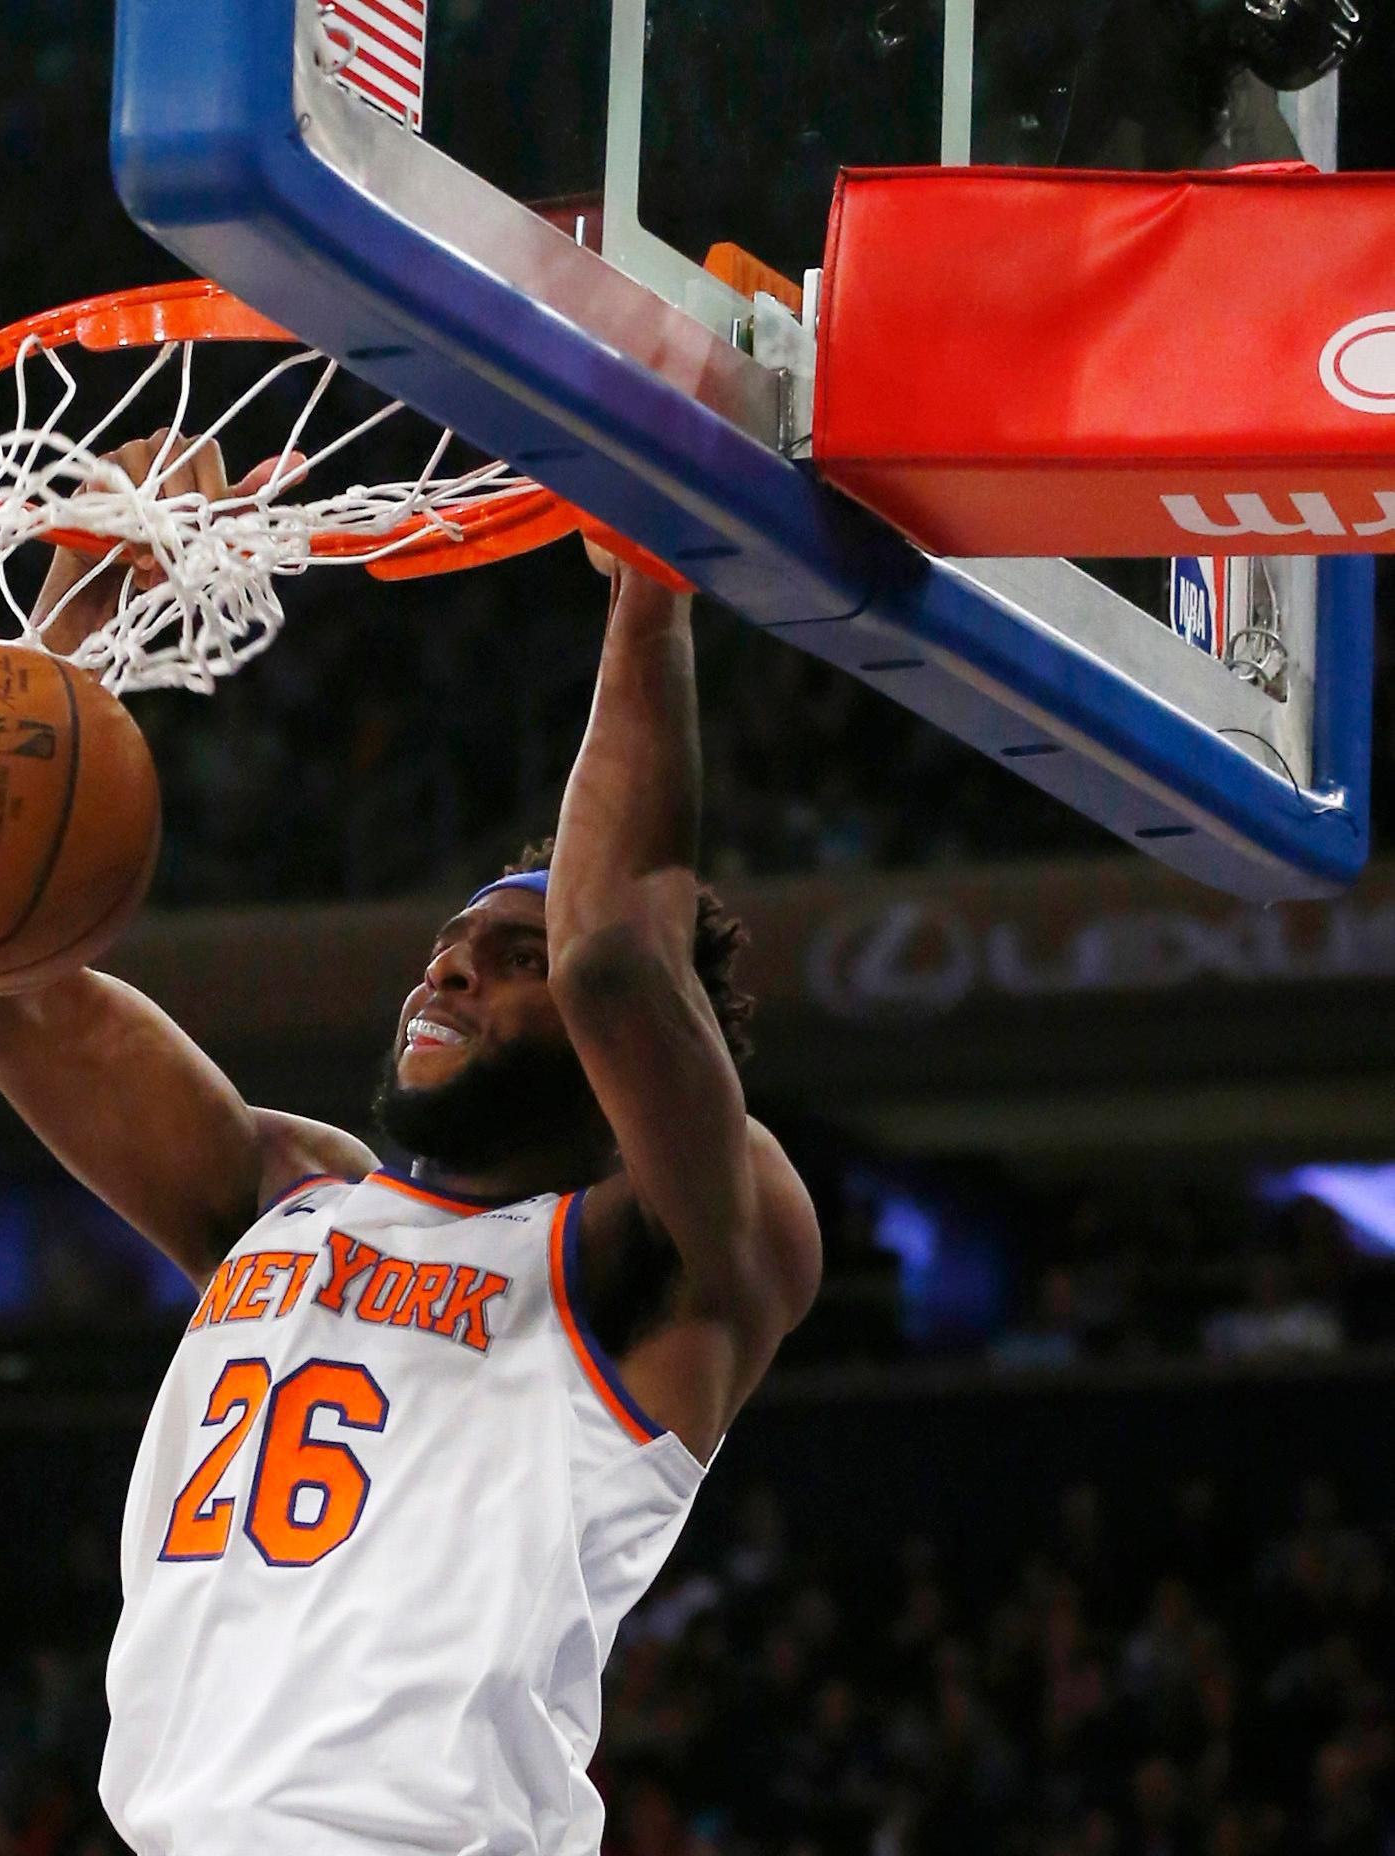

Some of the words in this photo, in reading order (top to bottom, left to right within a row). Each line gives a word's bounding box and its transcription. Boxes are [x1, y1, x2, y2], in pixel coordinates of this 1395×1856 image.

[1178, 575, 1206, 641] NBA
[312, 1226, 511, 1358] YORK
[157, 1357, 391, 1568] 26
